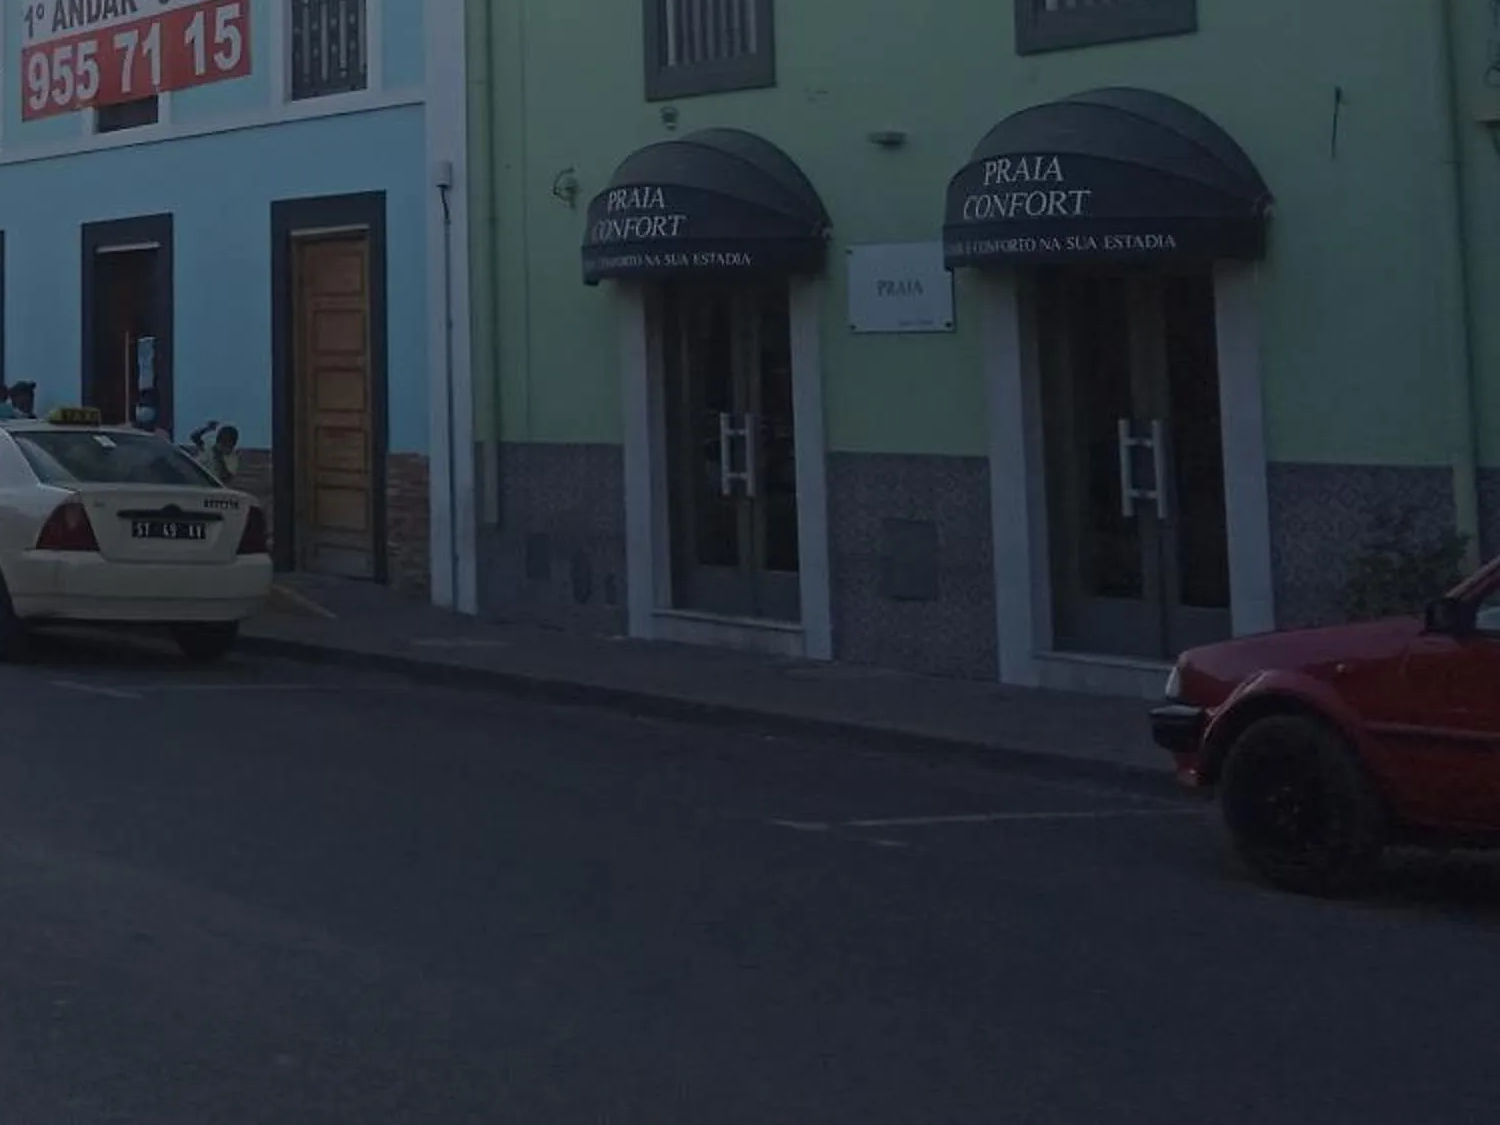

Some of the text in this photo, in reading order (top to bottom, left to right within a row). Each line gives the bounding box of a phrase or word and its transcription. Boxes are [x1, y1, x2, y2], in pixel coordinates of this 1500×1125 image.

[27, 2, 242, 111] 955 71 15
[983, 155, 1065, 186] PRAIA
[607, 186, 665, 214] PRAIA
[963, 189, 1092, 220] CONFORT
[592, 214, 687, 243] CONFORT
[1040, 236, 1061, 251] NA
[1066, 235, 1099, 251] SUA
[1104, 234, 1177, 251] ESTADIA
[663, 252, 689, 266] SUA
[691, 251, 753, 267] ESTADIA
[877, 279, 924, 297] PRAIA
